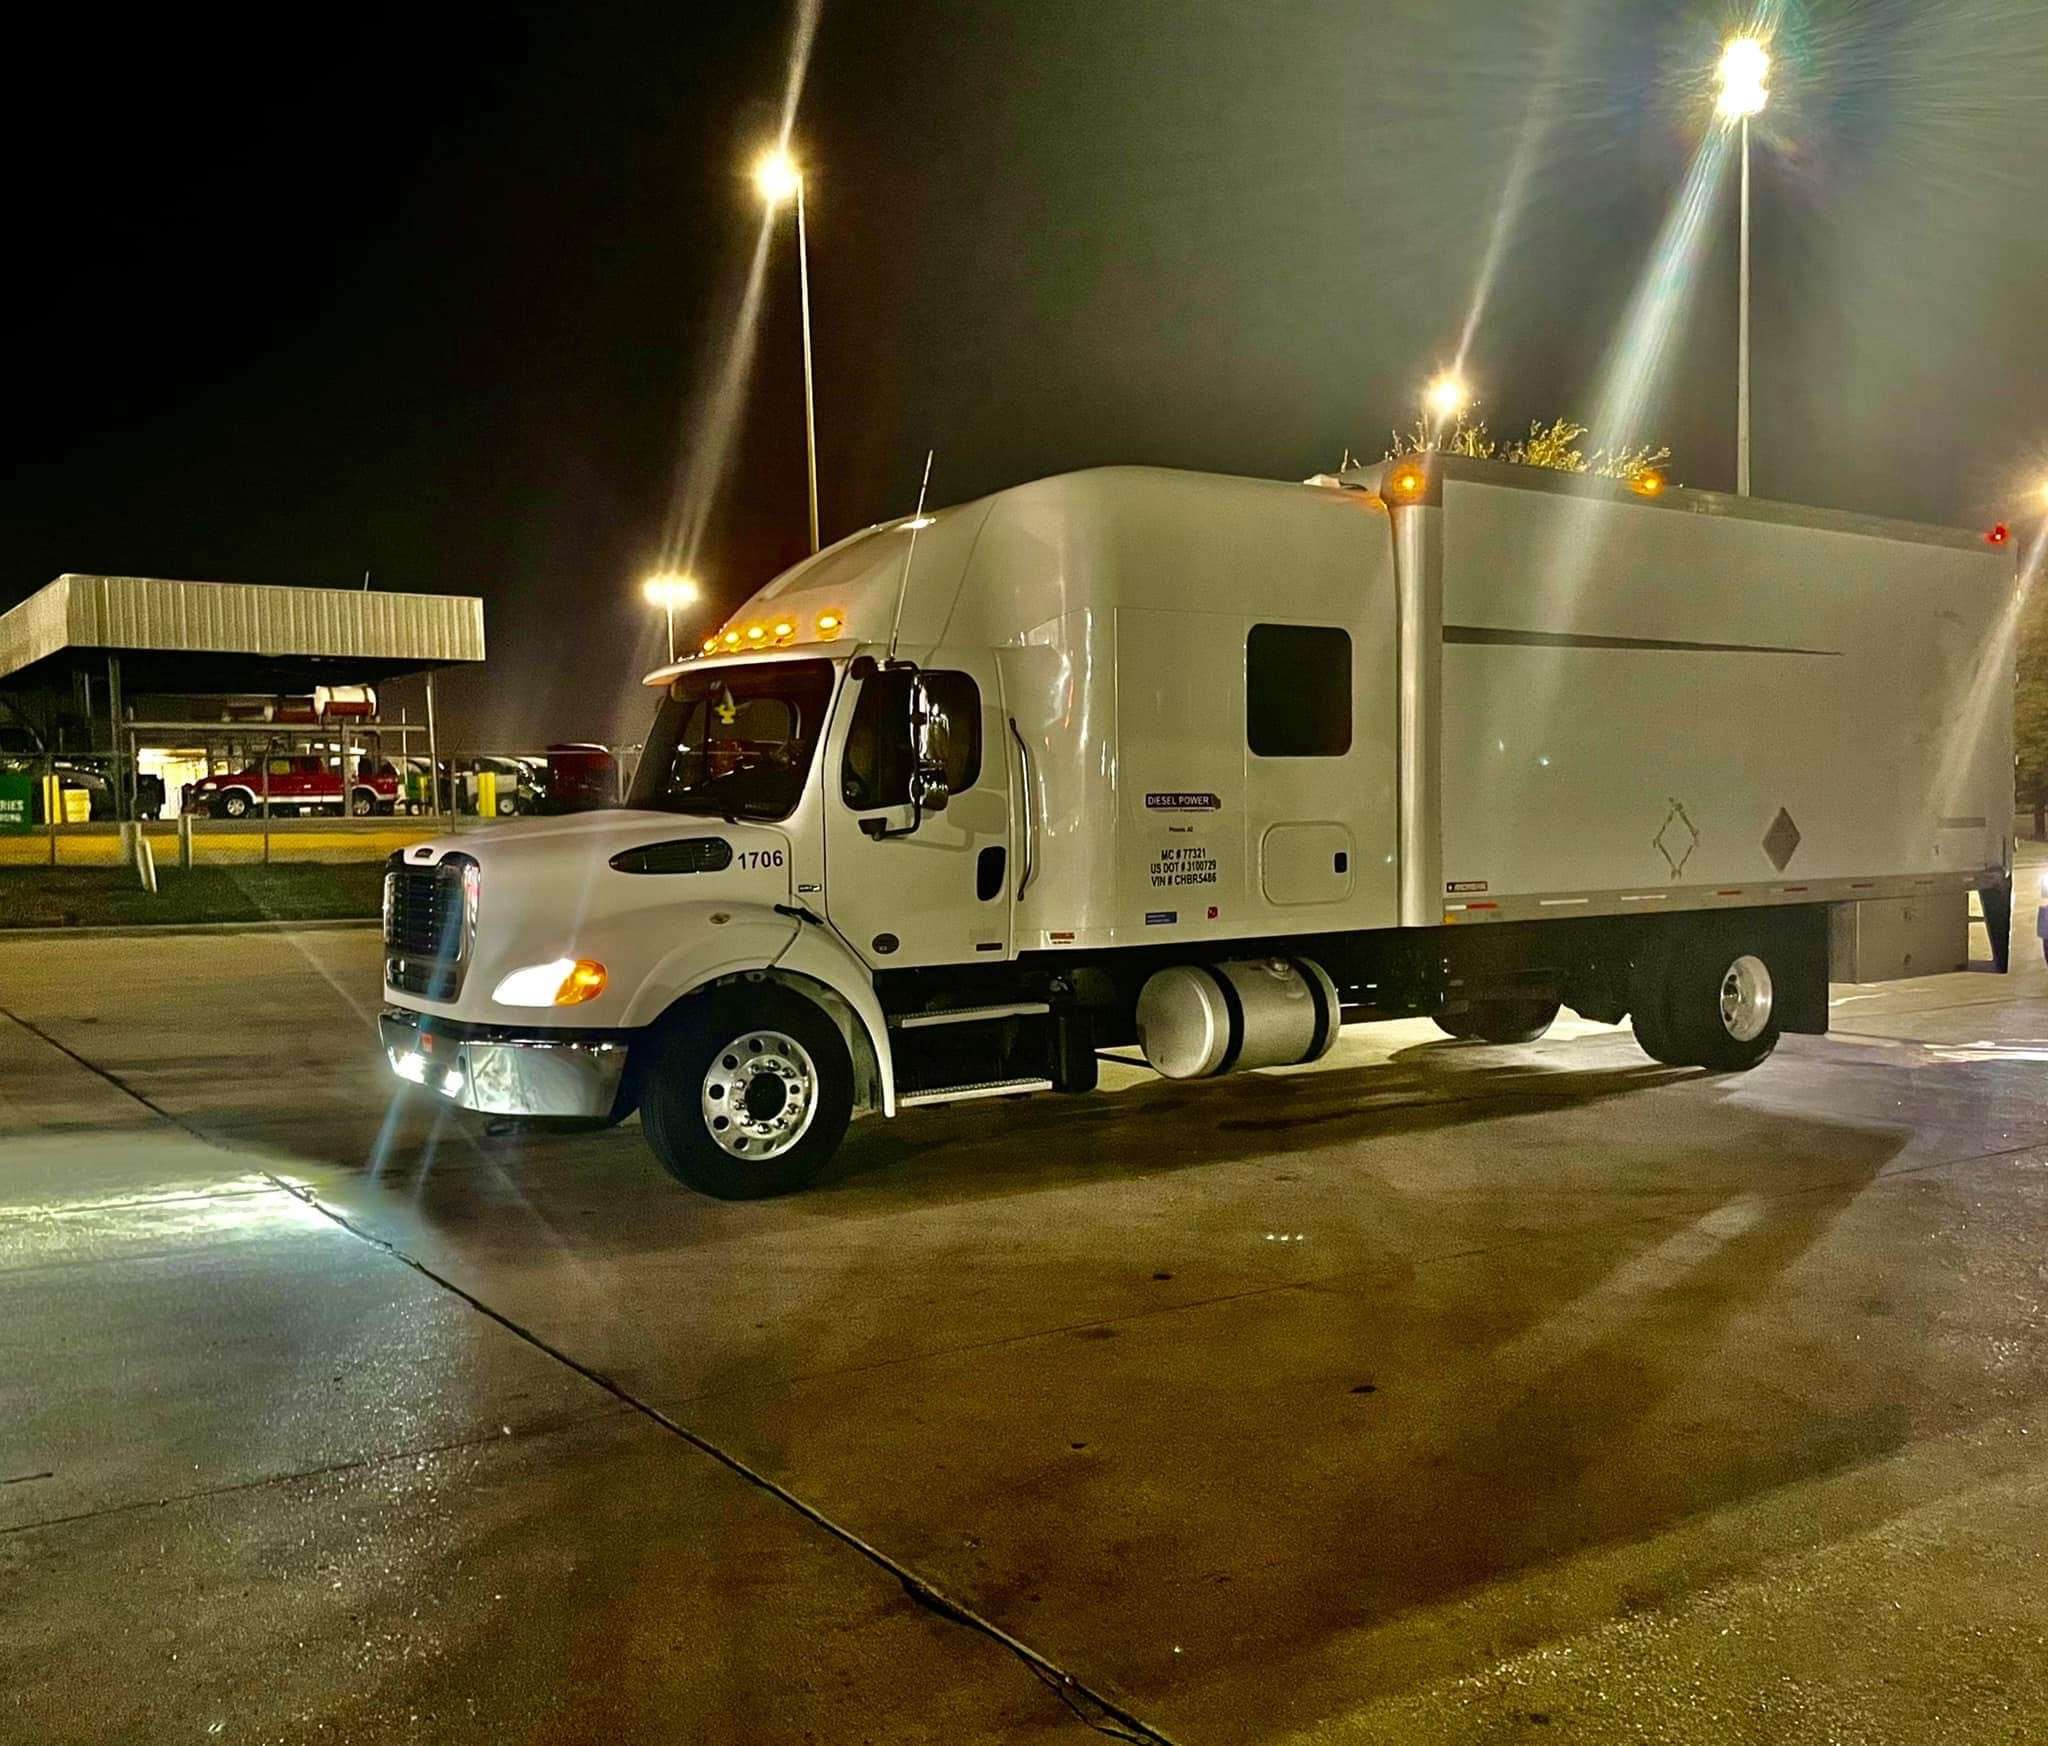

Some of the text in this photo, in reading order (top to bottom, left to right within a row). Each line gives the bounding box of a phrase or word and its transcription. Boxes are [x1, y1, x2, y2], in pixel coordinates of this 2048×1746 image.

[1147, 795, 1210, 806] DIESEL POWER
[737, 850, 784, 870] 1706
[1161, 849, 1175, 861] MC
[1150, 863, 1162, 874] US
[1163, 862, 1180, 874] DOT
[1151, 876, 1166, 887] VIN
